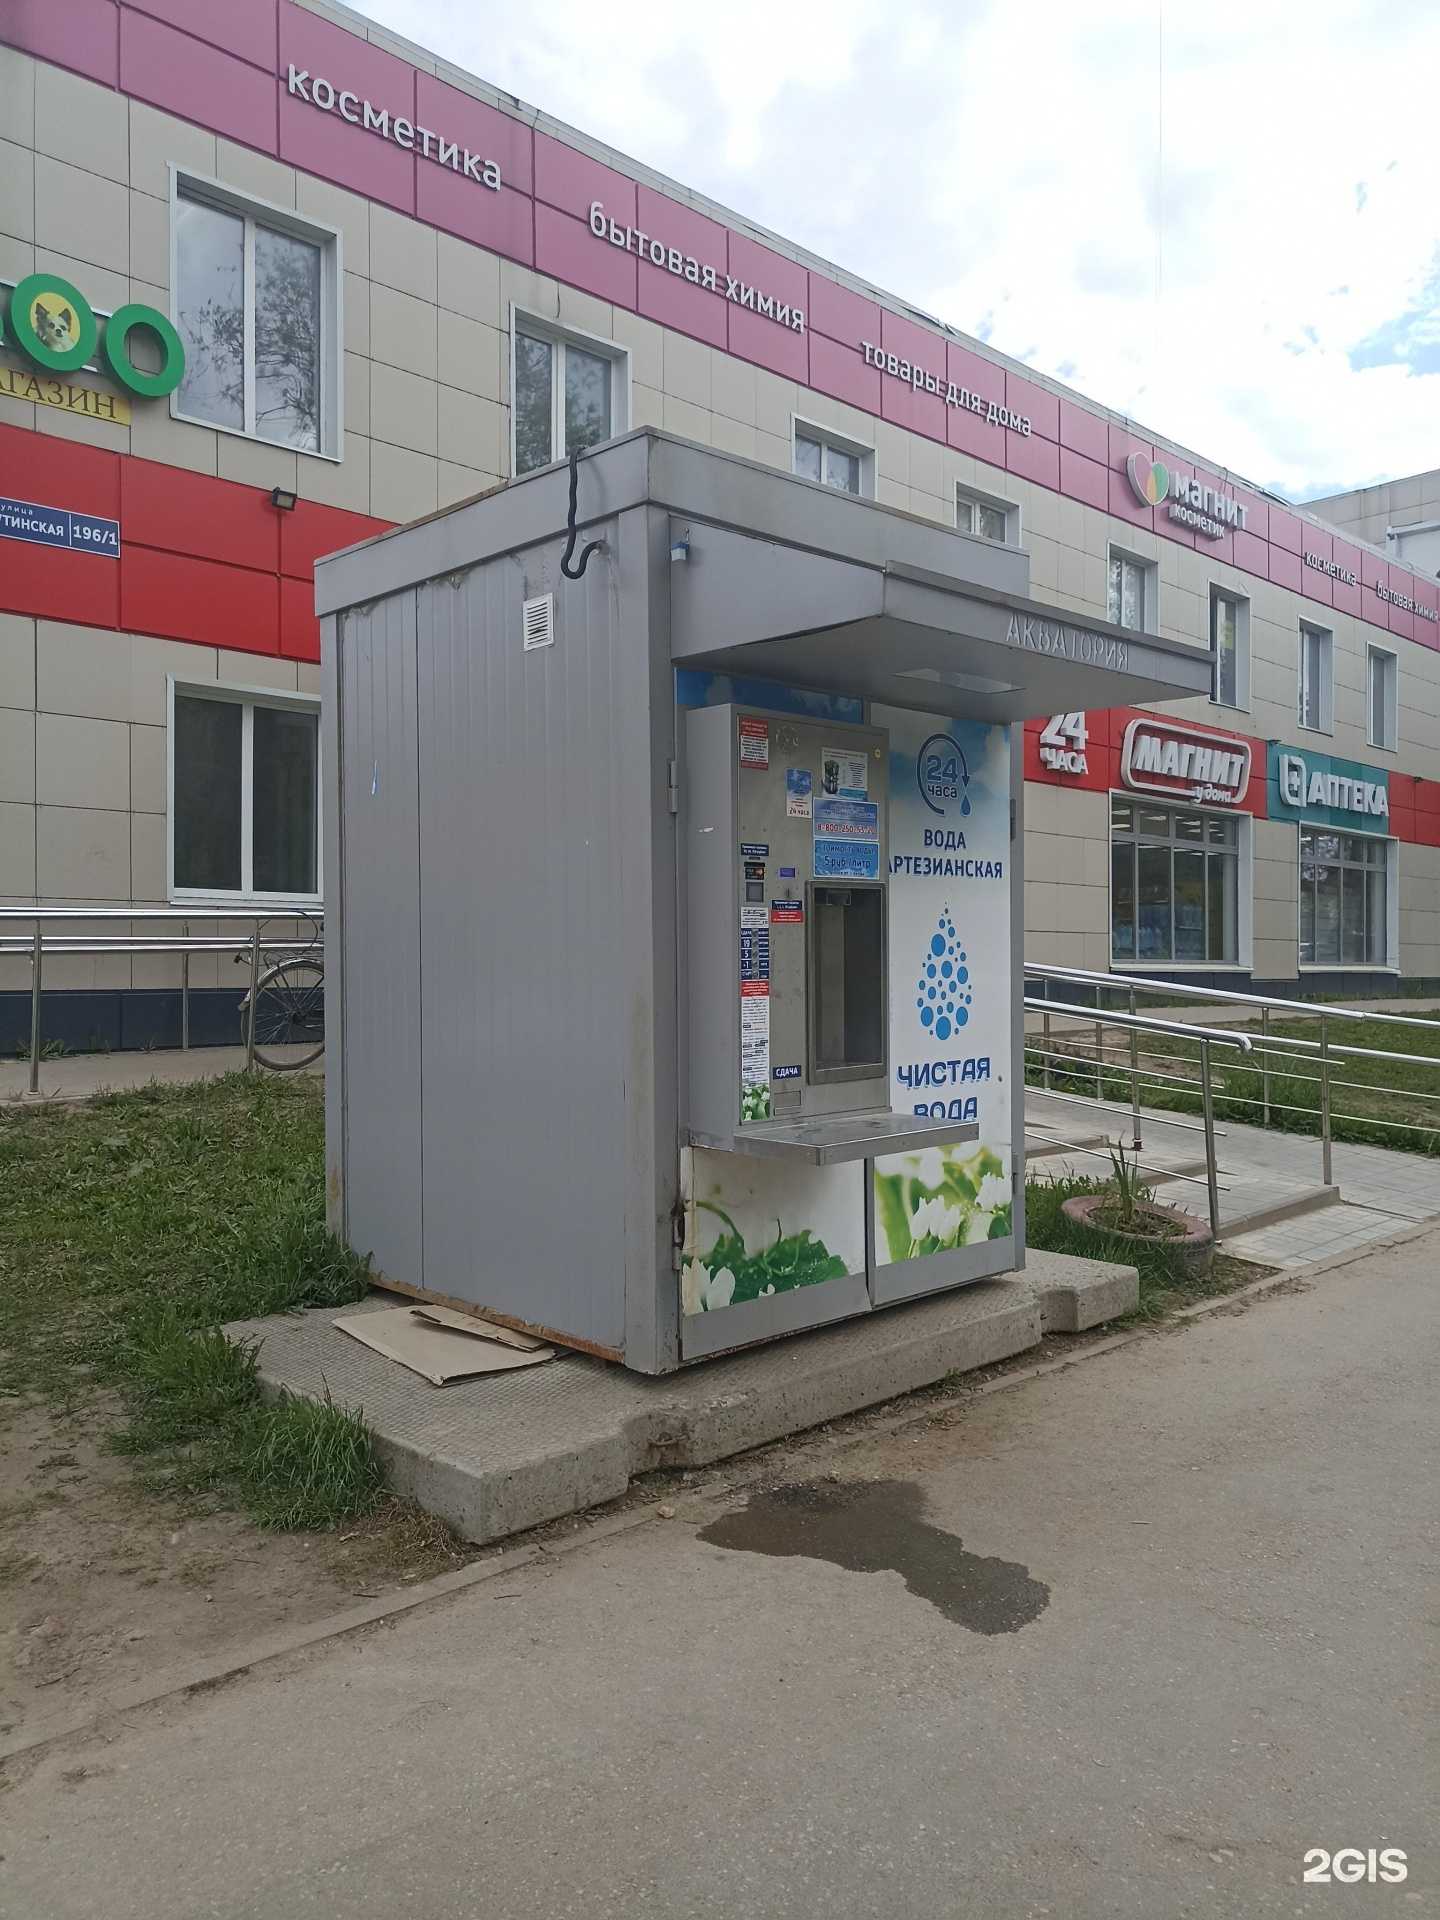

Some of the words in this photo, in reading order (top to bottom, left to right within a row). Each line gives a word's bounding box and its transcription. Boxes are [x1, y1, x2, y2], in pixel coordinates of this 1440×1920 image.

[288, 63, 502, 192] косметика
[589, 201, 717, 292] бытовая
[725, 274, 806, 334] химия
[0, 273, 186, 398] ОО
[861, 340, 941, 395] товары
[945, 382, 981, 413] для
[986, 401, 1032, 438] дома
[72, 524, 118, 547] 196/1
[1168, 502, 1225, 538] косметик
[1305, 551, 1358, 586] косметика
[1006, 613, 1129, 671] АКВАТОРИЯ
[1040, 711, 1088, 751] 24
[926, 754, 959, 784] 24
[1040, 747, 1089, 775] ЧАСА
[1131, 735, 1246, 787] МАГНИТ
[927, 783, 958, 799] часа
[1308, 771, 1390, 817] АПТЕКА
[924, 828, 967, 851] ВОДА
[775, 1067, 798, 1077] СДАЧА
[897, 1057, 990, 1089] ЧИСТАЯ
[913, 1097, 978, 1120] ВОДА
